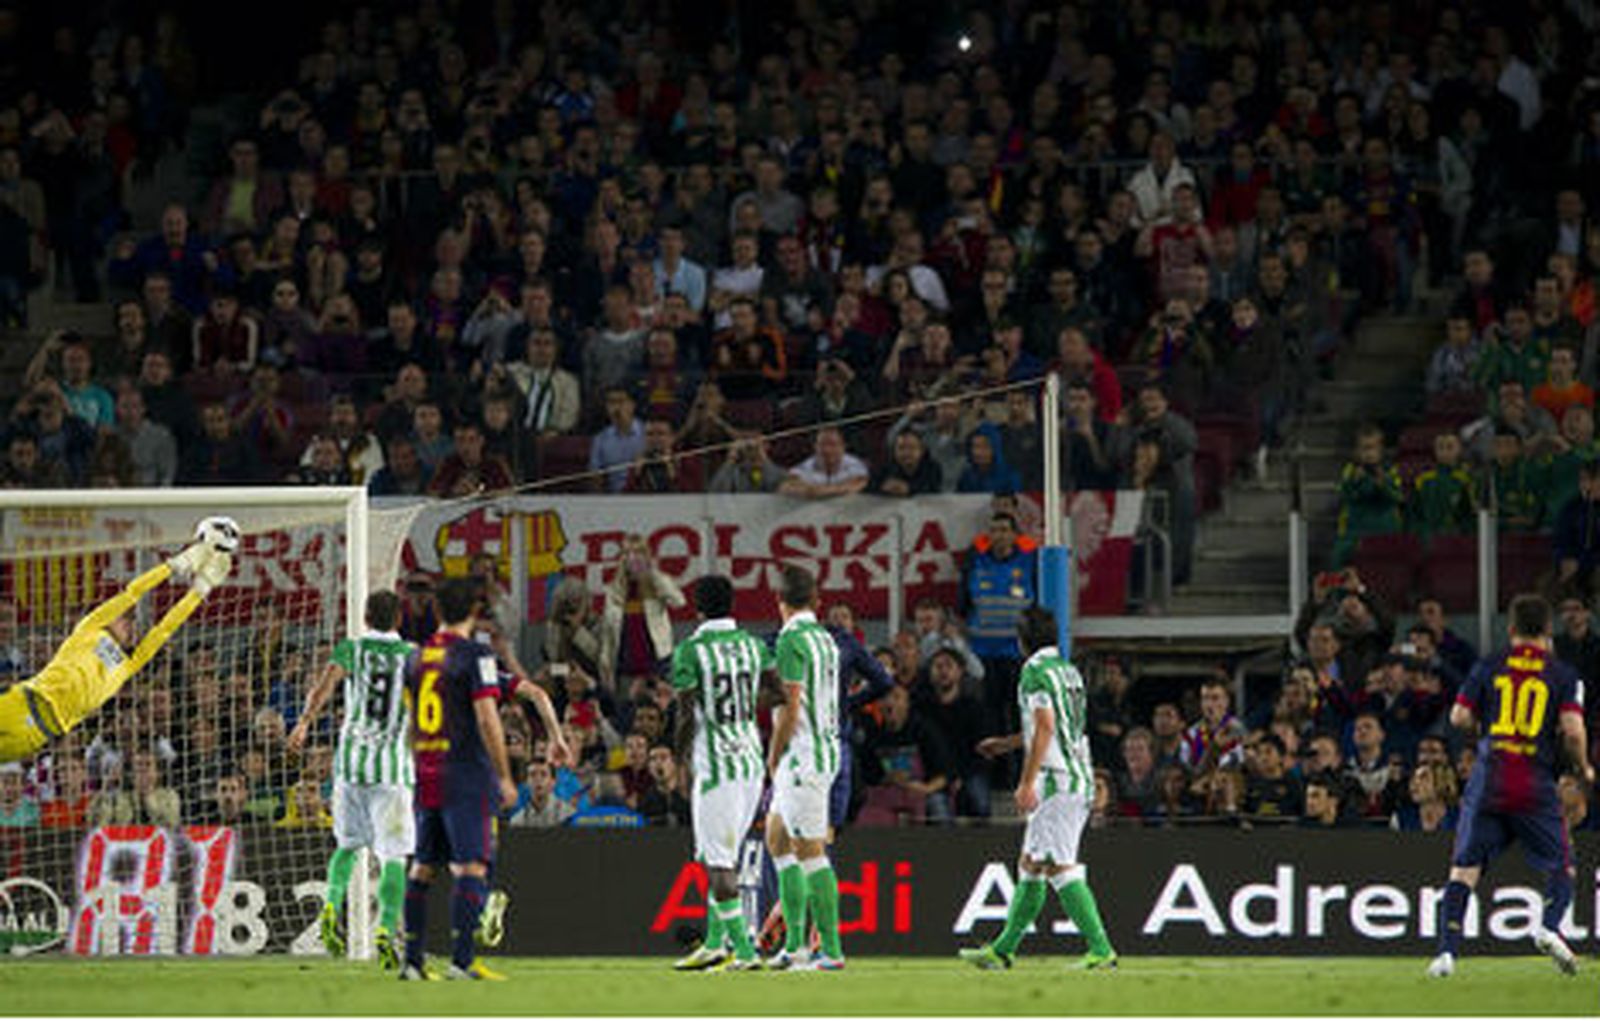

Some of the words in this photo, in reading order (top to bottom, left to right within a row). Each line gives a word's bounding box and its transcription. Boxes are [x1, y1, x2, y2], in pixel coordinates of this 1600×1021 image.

[581, 520, 957, 593] POLSKA
[417, 670, 443, 734] 6
[1490, 675, 1549, 737] 10
[650, 861, 912, 934] Adi
[953, 862, 1092, 933] A
